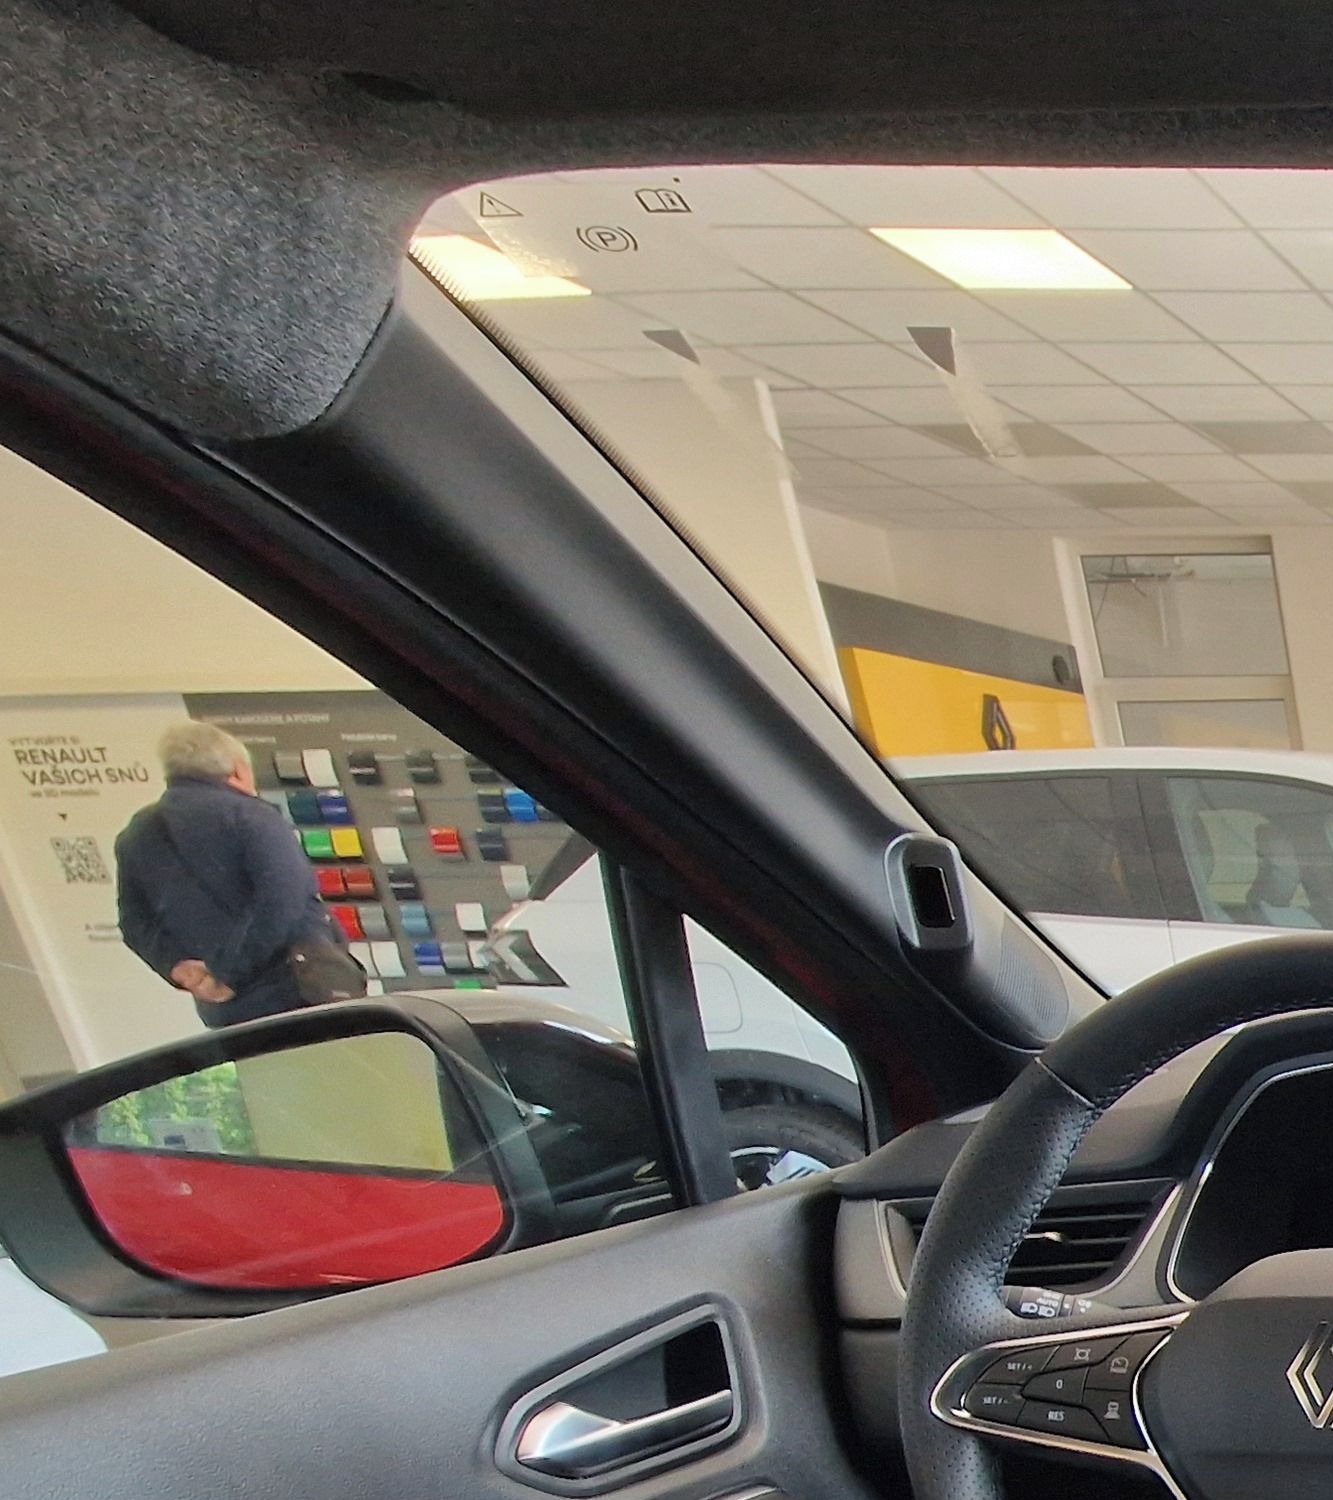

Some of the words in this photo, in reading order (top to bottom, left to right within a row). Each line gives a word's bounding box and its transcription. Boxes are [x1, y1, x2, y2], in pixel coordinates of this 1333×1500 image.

[14, 747, 107, 765] RENAULT
[21, 765, 103, 785] VAŠICH
[104, 762, 149, 783] SNŮ
[1048, 1411, 1064, 1421] RES
